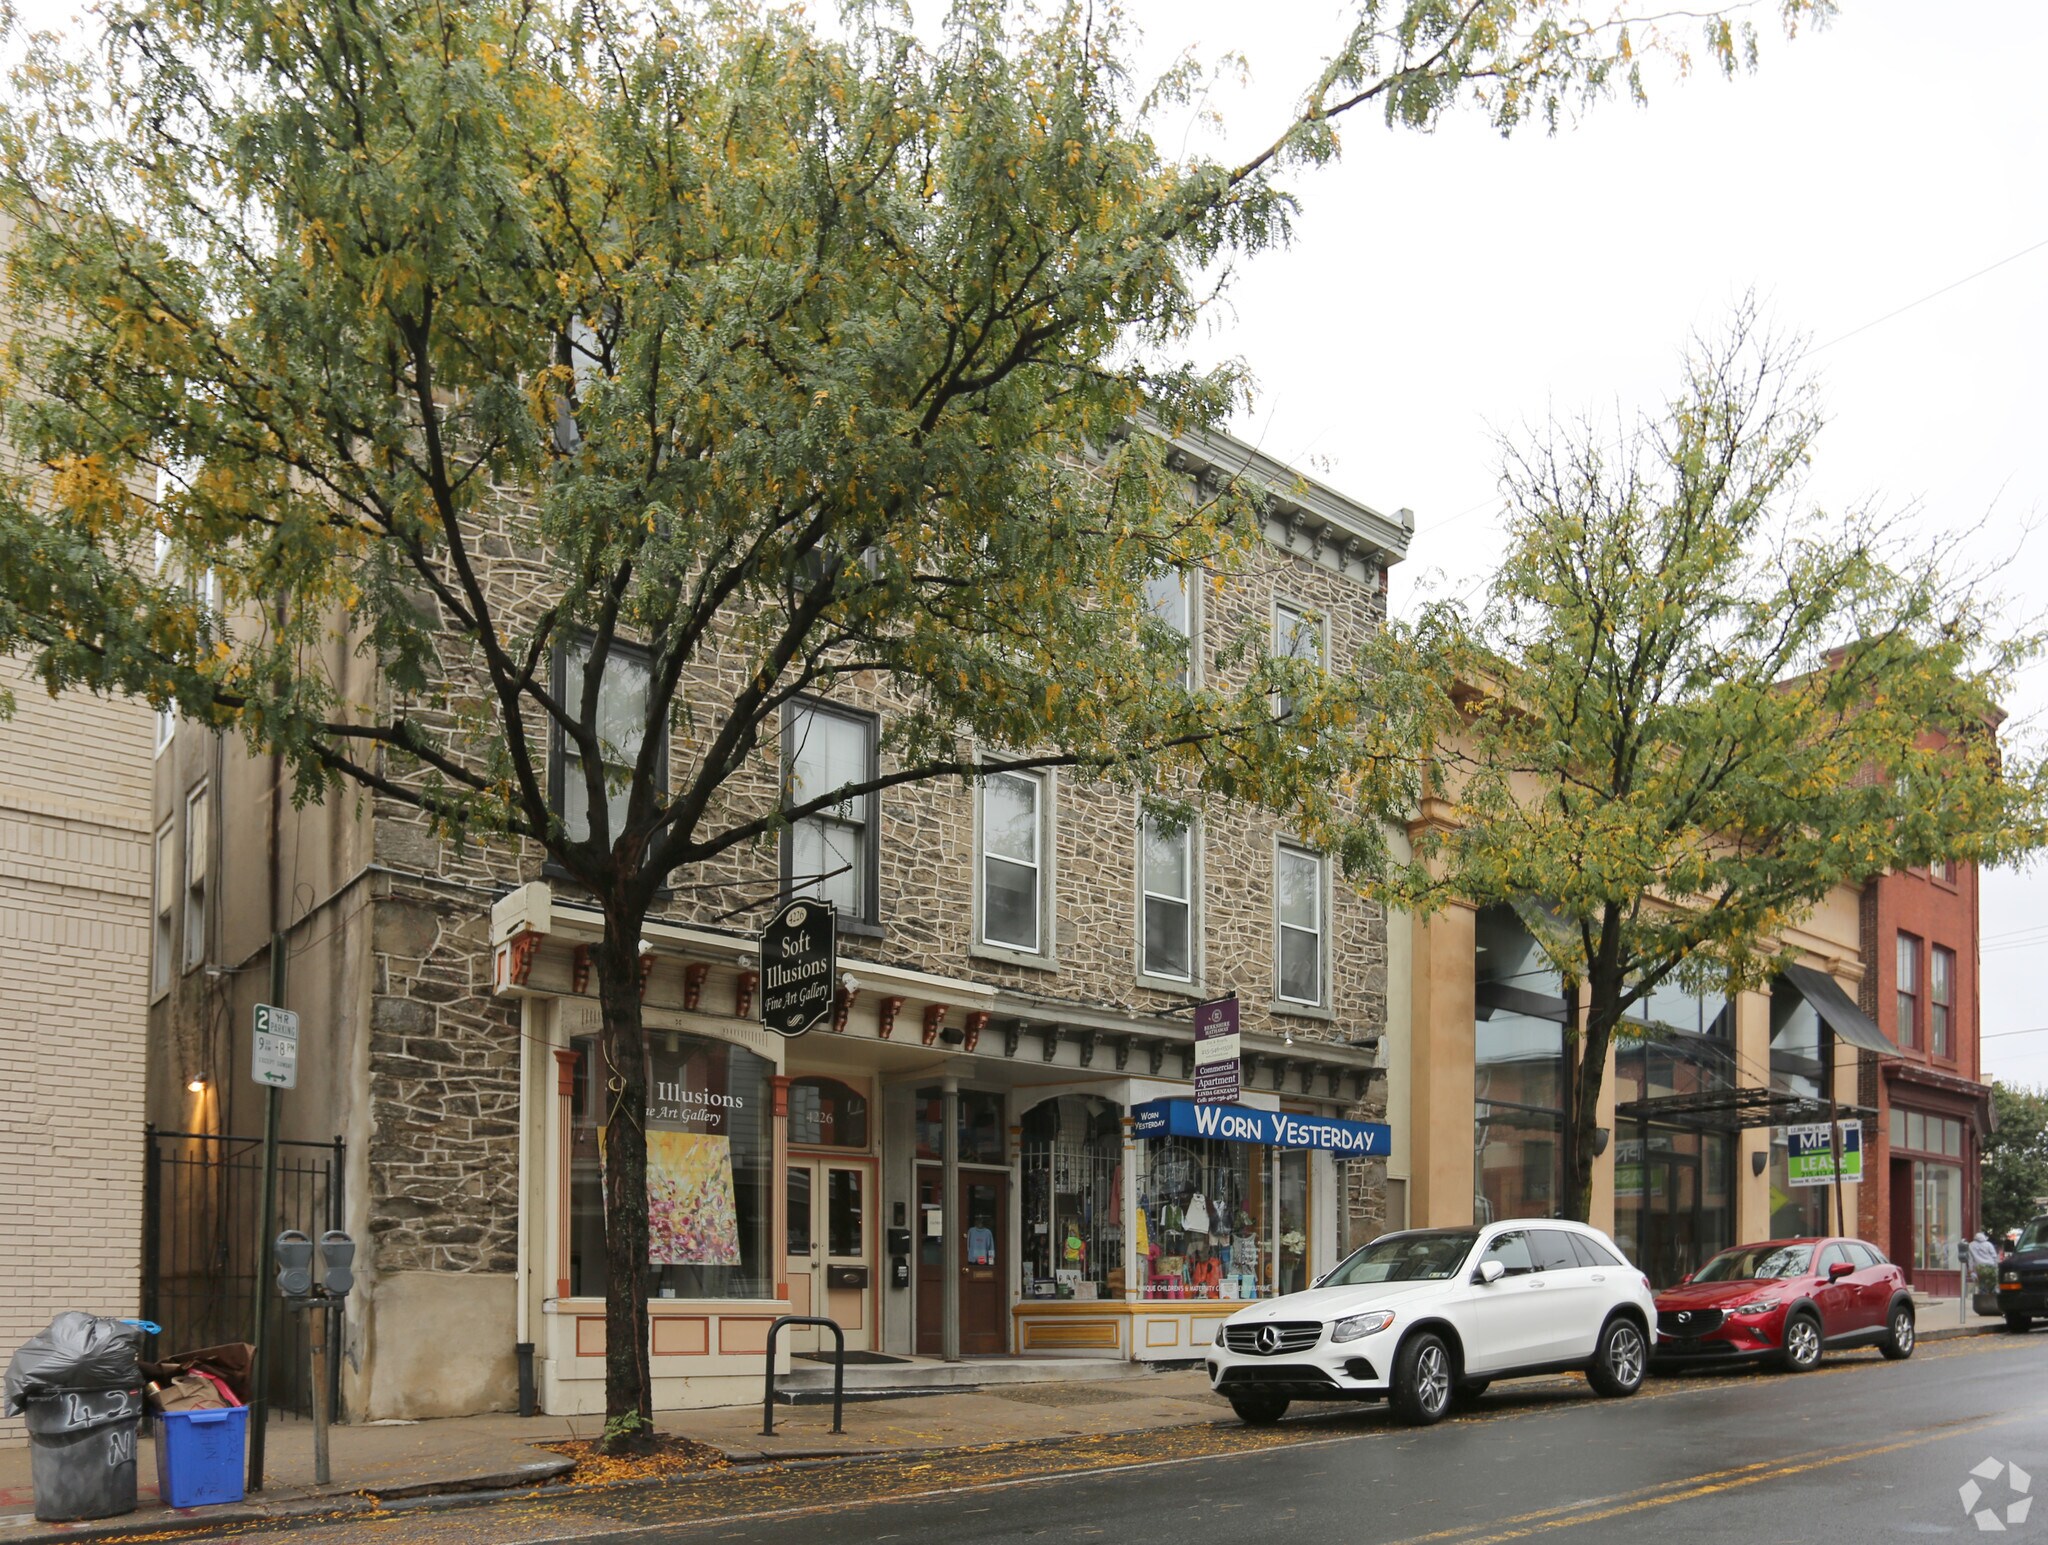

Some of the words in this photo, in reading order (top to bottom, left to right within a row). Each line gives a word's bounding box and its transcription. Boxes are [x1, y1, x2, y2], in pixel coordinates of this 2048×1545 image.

[788, 909, 805, 925] 4226
[782, 930, 811, 958] Soft
[766, 958, 827, 989] Illusions
[765, 996, 782, 1012] Fine
[782, 991, 798, 1009] Art
[799, 981, 828, 1007] Gallery
[257, 1009, 269, 1030] 2
[275, 1013, 289, 1025] HR
[1204, 1021, 1230, 1032] BERKSHIRE
[270, 1022, 295, 1037] PARKING
[1205, 1027, 1229, 1036] HATHAWAY
[259, 1036, 265, 1050] 9
[287, 1042, 295, 1053] PM
[1200, 1061, 1234, 1075] Commercial
[1198, 1074, 1236, 1089] Apartment
[657, 1081, 744, 1109] Illusions
[1197, 1089, 1213, 1097] LINDA
[1213, 1087, 1238, 1095] GENZANO
[656, 1106, 678, 1119] Art
[681, 1107, 721, 1126] Gallery
[806, 1111, 834, 1124] 4226
[1140, 1111, 1160, 1121] WORN
[1134, 1119, 1165, 1130] YESTERDAY
[1194, 1104, 1262, 1141] WORN
[1271, 1114, 1374, 1151] YESTERDAY
